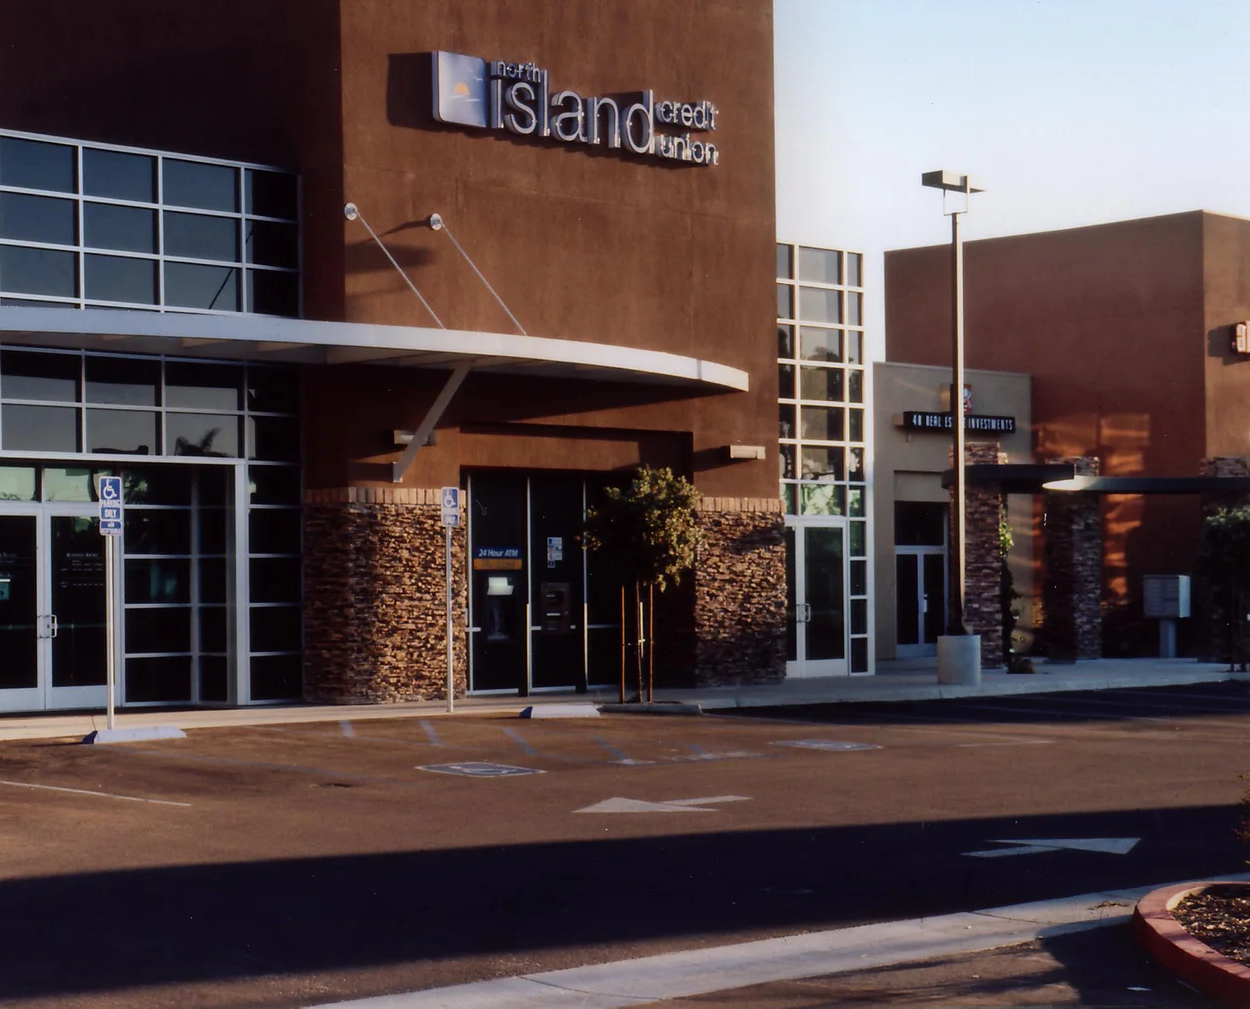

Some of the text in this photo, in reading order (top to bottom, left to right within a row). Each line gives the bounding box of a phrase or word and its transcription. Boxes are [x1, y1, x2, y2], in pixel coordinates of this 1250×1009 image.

[491, 60, 541, 83] north
[491, 69, 654, 154] island
[656, 100, 717, 130] credit
[656, 133, 718, 165] union
[968, 418, 1013, 431] INVESTMENTS
[478, 548, 519, 558] 24 Hour ATM
